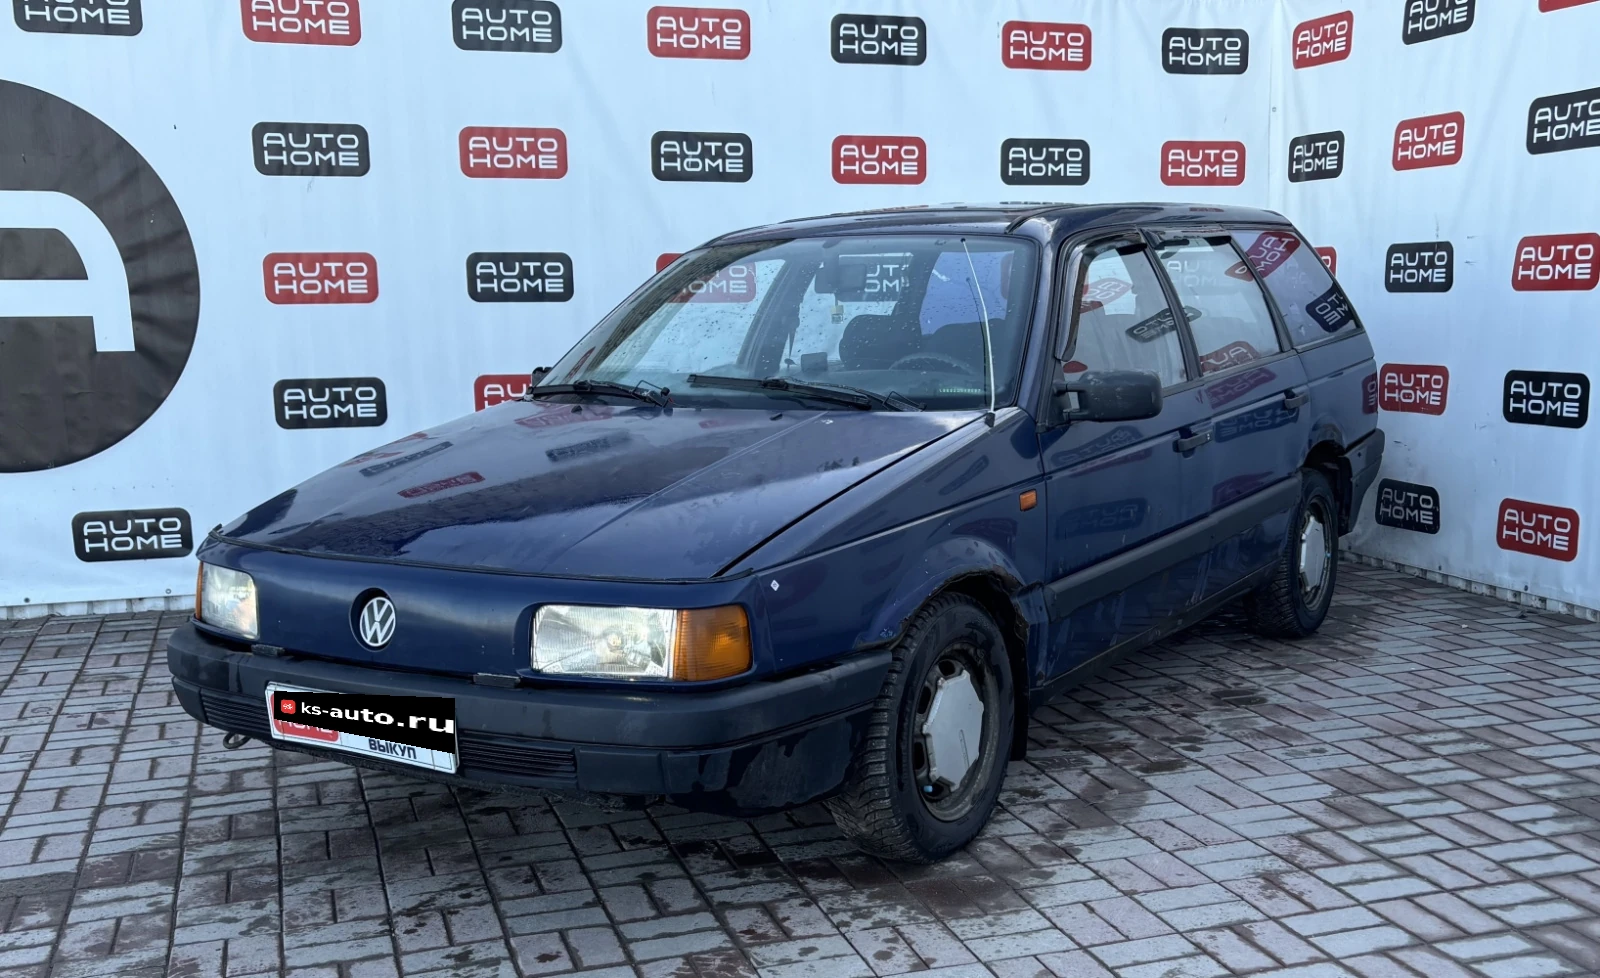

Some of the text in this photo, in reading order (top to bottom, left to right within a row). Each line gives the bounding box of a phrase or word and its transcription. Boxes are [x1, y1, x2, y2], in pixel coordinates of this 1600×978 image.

[25, 5, 131, 25] HOME
[252, 0, 349, 17] AUTO
[462, 8, 552, 25] AUTO
[1410, 0, 1468, 17] AU
[253, 15, 351, 35] HOME
[657, 16, 741, 33] AUTO
[1408, 6, 1468, 34] HOME
[463, 25, 553, 43] HOME
[840, 23, 918, 39] AUTO
[1010, 30, 1084, 46] AUTO
[1297, 21, 1348, 44] AUTO
[657, 33, 741, 50] HOME
[840, 40, 918, 56] HOME
[1170, 37, 1241, 51] AUTO
[1296, 37, 1347, 60] HOME
[1010, 46, 1084, 62] HOME
[1170, 52, 1241, 66] HOME
[1535, 98, 1600, 124] AUTO
[1399, 122, 1457, 144] AUTO
[1534, 118, 1600, 143] HOME
[263, 132, 358, 148] AUTO
[469, 137, 558, 152] AUTO
[661, 141, 744, 156] AUTO
[841, 145, 918, 159] AUTO
[1009, 148, 1082, 160] AUTO
[1168, 149, 1238, 162] AUTO
[1294, 140, 1339, 158] AUTO
[1398, 140, 1456, 161] HOME
[264, 150, 360, 166] HOME
[470, 153, 558, 169] HOME
[661, 157, 744, 172] HOME
[1292, 156, 1338, 174] HOME
[841, 161, 918, 175] HOME
[1009, 163, 1082, 177] HOME
[1168, 164, 1238, 177] HOME
[1391, 251, 1447, 267] AUTO
[1520, 244, 1593, 262] AUTO
[274, 262, 368, 277] AUTO
[476, 262, 564, 276] AUTO
[1390, 269, 1447, 283] HOME
[1518, 263, 1592, 280] HOME
[275, 279, 369, 294] HOME
[477, 279, 564, 292] HOME
[683, 280, 747, 294] OME
[1385, 372, 1443, 388] AUTO
[284, 387, 377, 402] AUTO
[484, 384, 532, 398] AU
[1385, 388, 1442, 405] HOME
[1511, 380, 1581, 398] AUTO
[285, 404, 377, 420] HOME
[1510, 398, 1580, 417] HOME
[1381, 488, 1433, 508] AUTO
[1380, 504, 1433, 524] HOME
[1504, 509, 1570, 532] AUTO
[84, 518, 181, 536] AUTO
[85, 534, 183, 553] HOME
[1503, 525, 1569, 550] HOME
[369, 738, 417, 760] ВЫКУП
